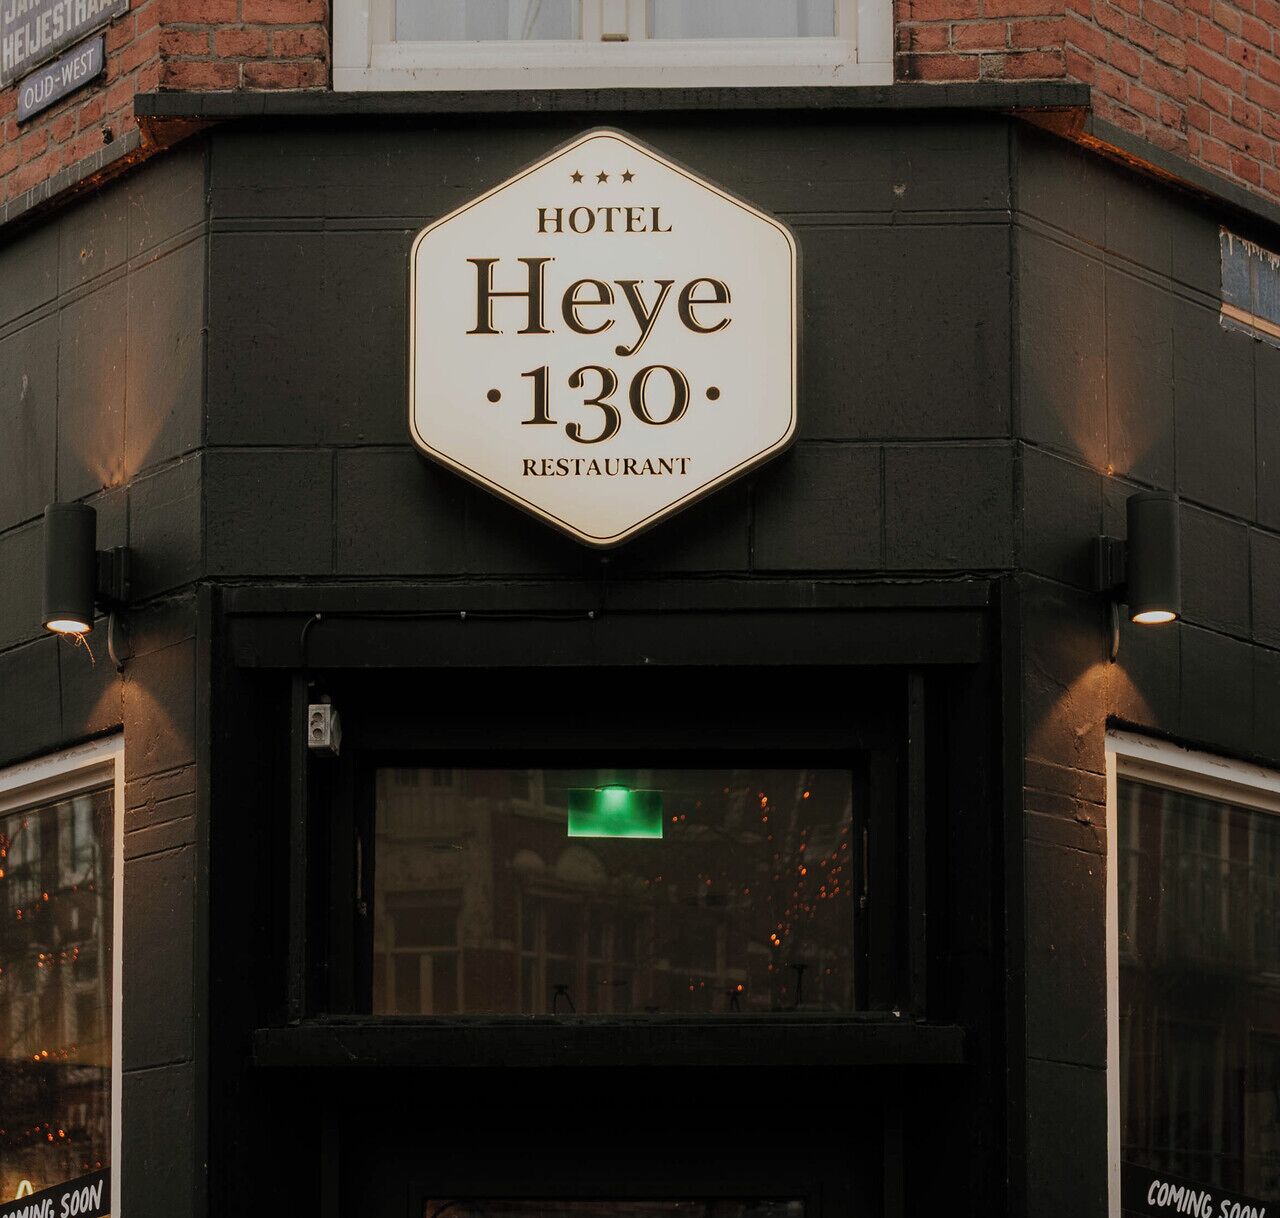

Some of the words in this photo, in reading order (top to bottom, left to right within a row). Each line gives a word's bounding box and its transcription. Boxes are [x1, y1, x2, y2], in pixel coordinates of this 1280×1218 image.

[24, 48, 95, 109] OUD-WEST
[537, 205, 673, 234] HOTEL
[465, 257, 733, 357] Heye
[520, 364, 692, 444] 130
[521, 457, 692, 477] RESTAURANT
